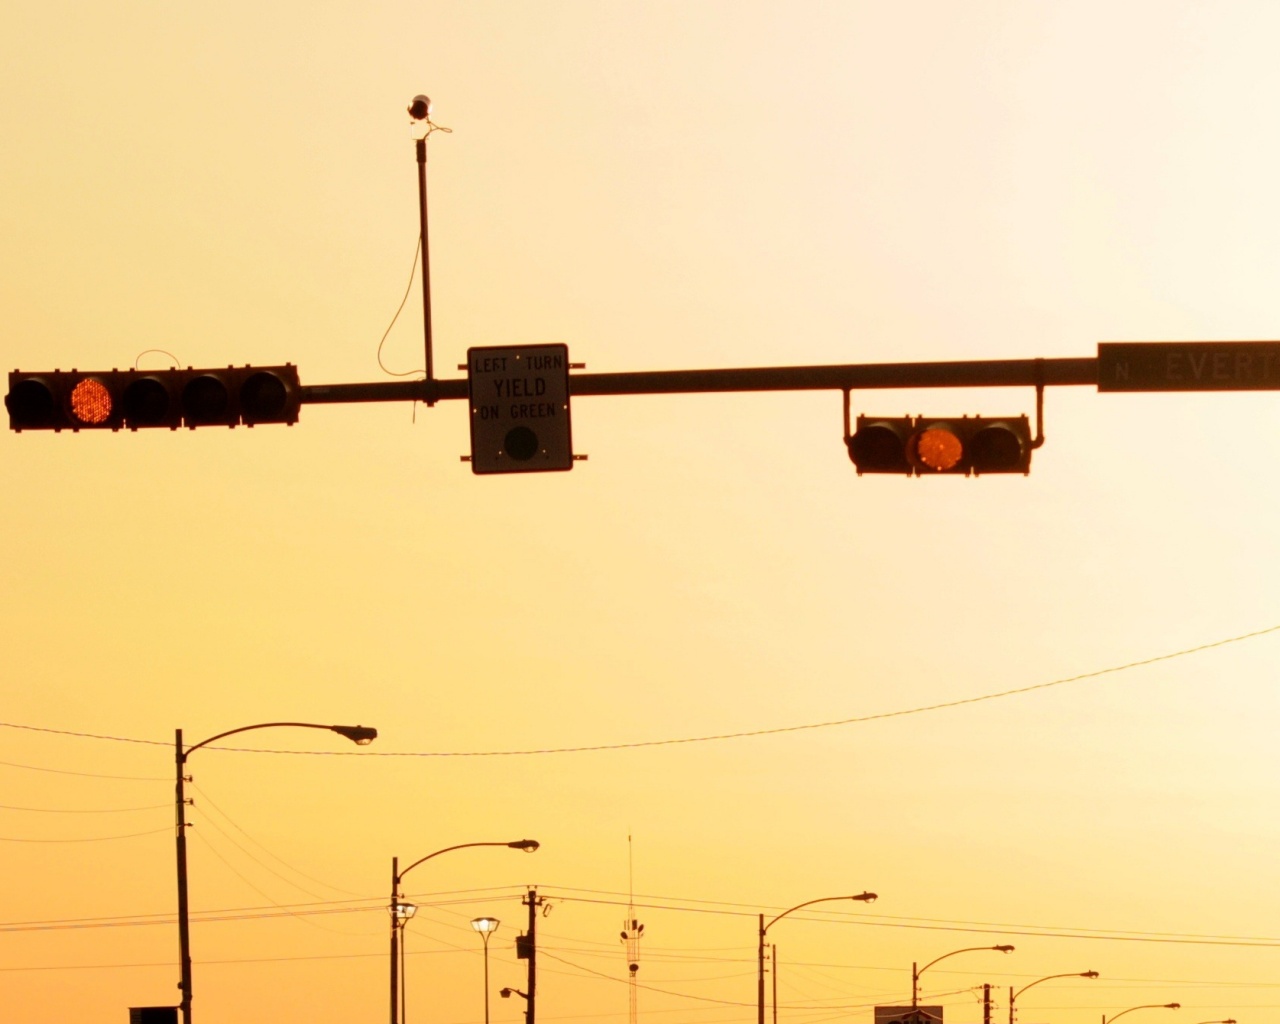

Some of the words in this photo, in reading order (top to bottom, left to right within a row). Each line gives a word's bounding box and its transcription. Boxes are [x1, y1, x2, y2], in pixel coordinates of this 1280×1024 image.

[474, 357, 509, 373] LEFT
[525, 355, 563, 371] TURN
[1115, 362, 1130, 381] N
[493, 377, 547, 398] YIELD
[480, 405, 500, 420] ON
[509, 402, 556, 419] GREEN
